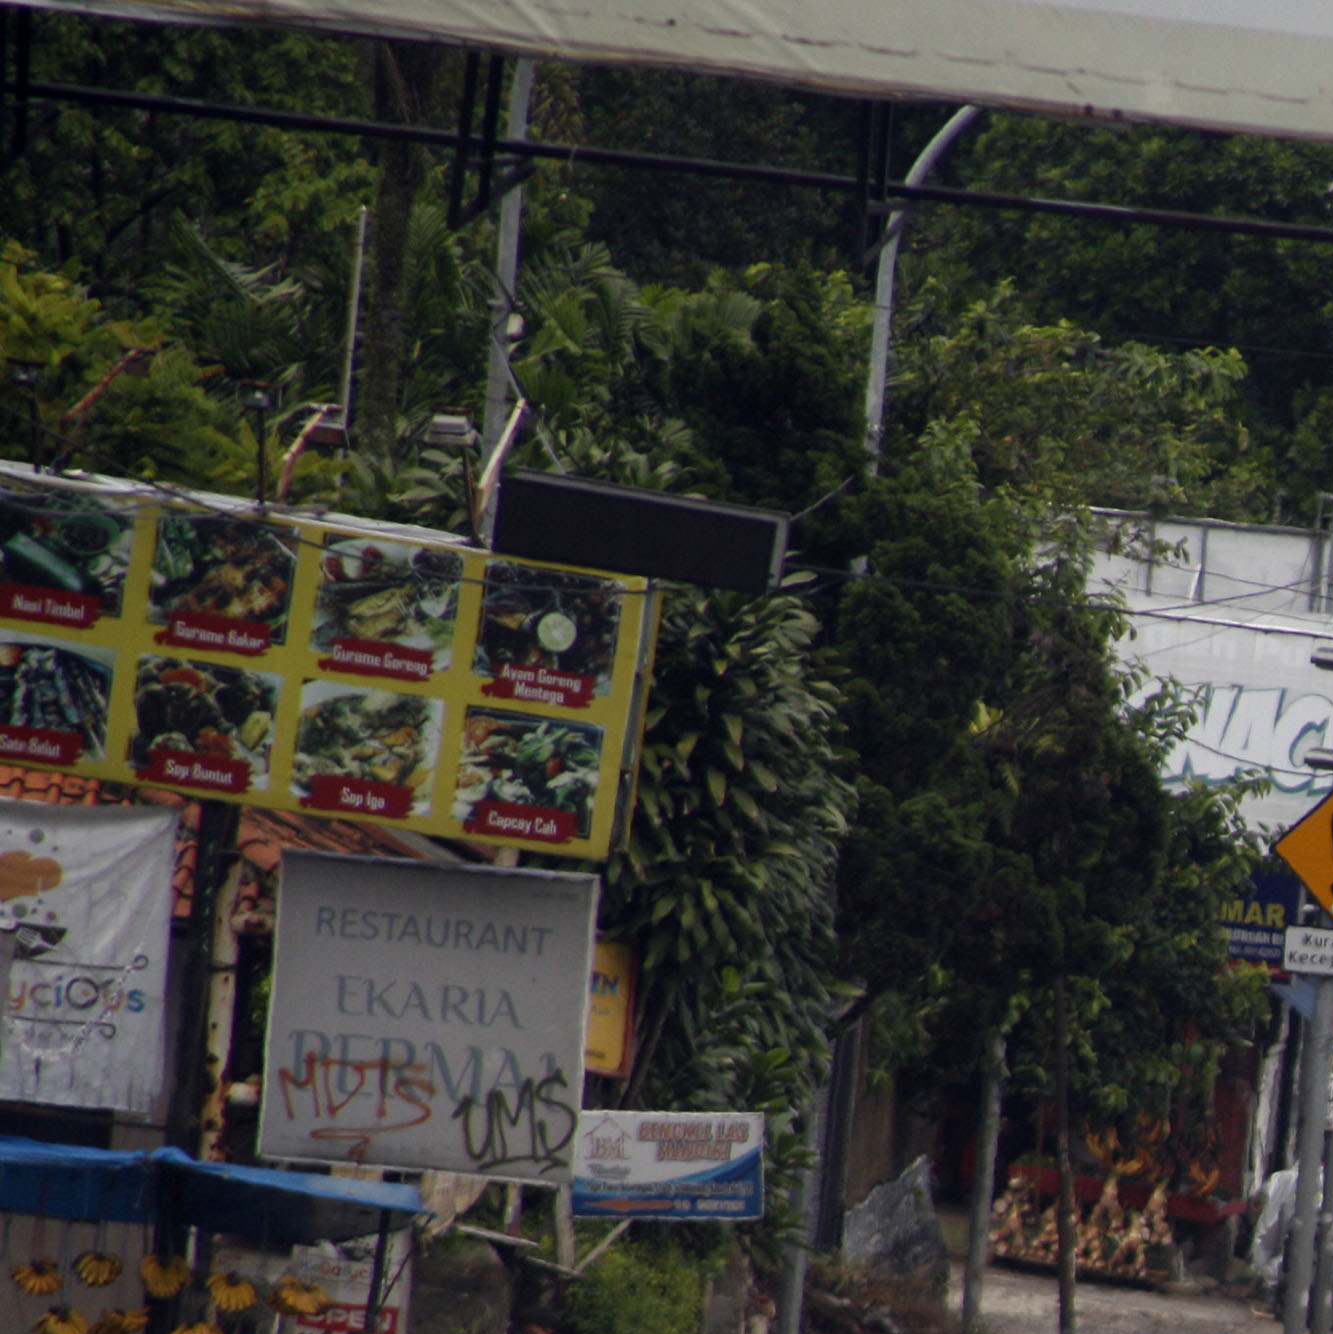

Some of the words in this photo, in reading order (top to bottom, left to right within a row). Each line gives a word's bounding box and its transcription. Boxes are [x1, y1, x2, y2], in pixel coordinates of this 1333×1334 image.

[175, 620, 226, 645] Gurame
[333, 644, 382, 668] Gurame
[383, 653, 428, 676] Goreng
[502, 664, 535, 683] Ayam
[537, 669, 582, 692] Goreng
[514, 680, 565, 703] Mentega
[194, 762, 233, 784] Buntut
[340, 786, 365, 806] Sop
[488, 810, 533, 835] Capcay
[534, 816, 557, 836] Cah
[314, 905, 553, 956] RESTAURANT
[333, 973, 526, 1031] EKARIA
